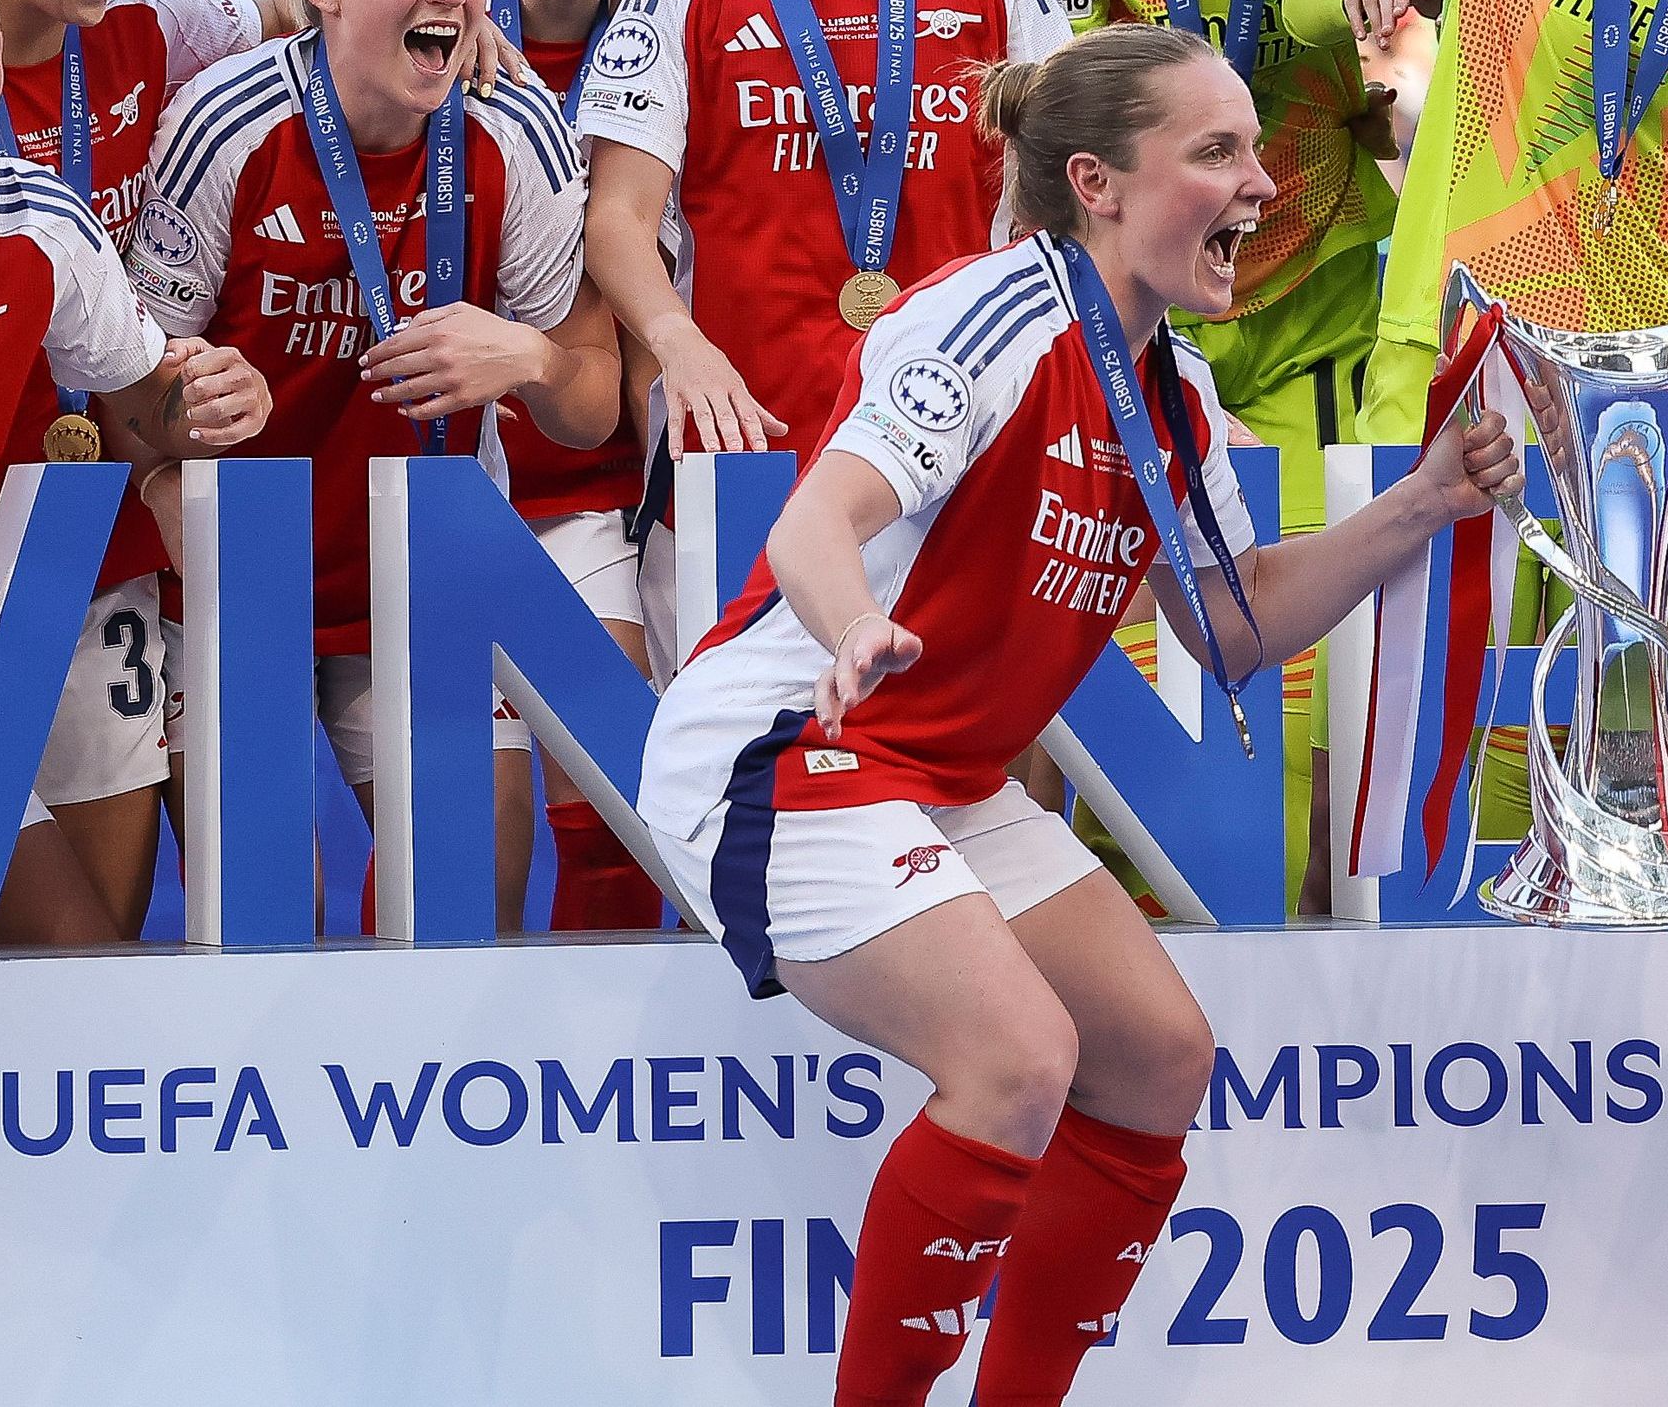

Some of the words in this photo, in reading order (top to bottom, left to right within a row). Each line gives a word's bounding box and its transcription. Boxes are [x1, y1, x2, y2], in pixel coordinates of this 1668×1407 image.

[827, 15, 868, 27] LISBON
[1238, 3, 1253, 42] FINAL
[798, 28, 821, 68] FINAL
[889, 44, 902, 85] FINAL
[70, 53, 83, 100] LISBON
[308, 68, 331, 120] LISBON
[329, 137, 348, 179] FINAL
[440, 100, 452, 142] FINAL
[735, 78, 969, 129] Emrtes
[818, 90, 846, 137] LISBON
[1603, 92, 1618, 142] LISBON
[72, 124, 82, 165] FINAL
[773, 132, 821, 172] FLY
[437, 166, 454, 214] LISBON
[871, 198, 889, 247] LISBON
[371, 285, 393, 332] LISBON
[1087, 302, 1112, 345] FINAL
[285, 320, 337, 356] FLY
[1109, 369, 1136, 420] LISBON
[1032, 558, 1080, 605] FLY
[101, 606, 159, 720] 3
[0, 1067, 290, 1157] UEFA
[320, 1051, 885, 1150] WOMEN'S
[1187, 1038, 1665, 1132] MPIONS
[1166, 1202, 1551, 1348] 2025
